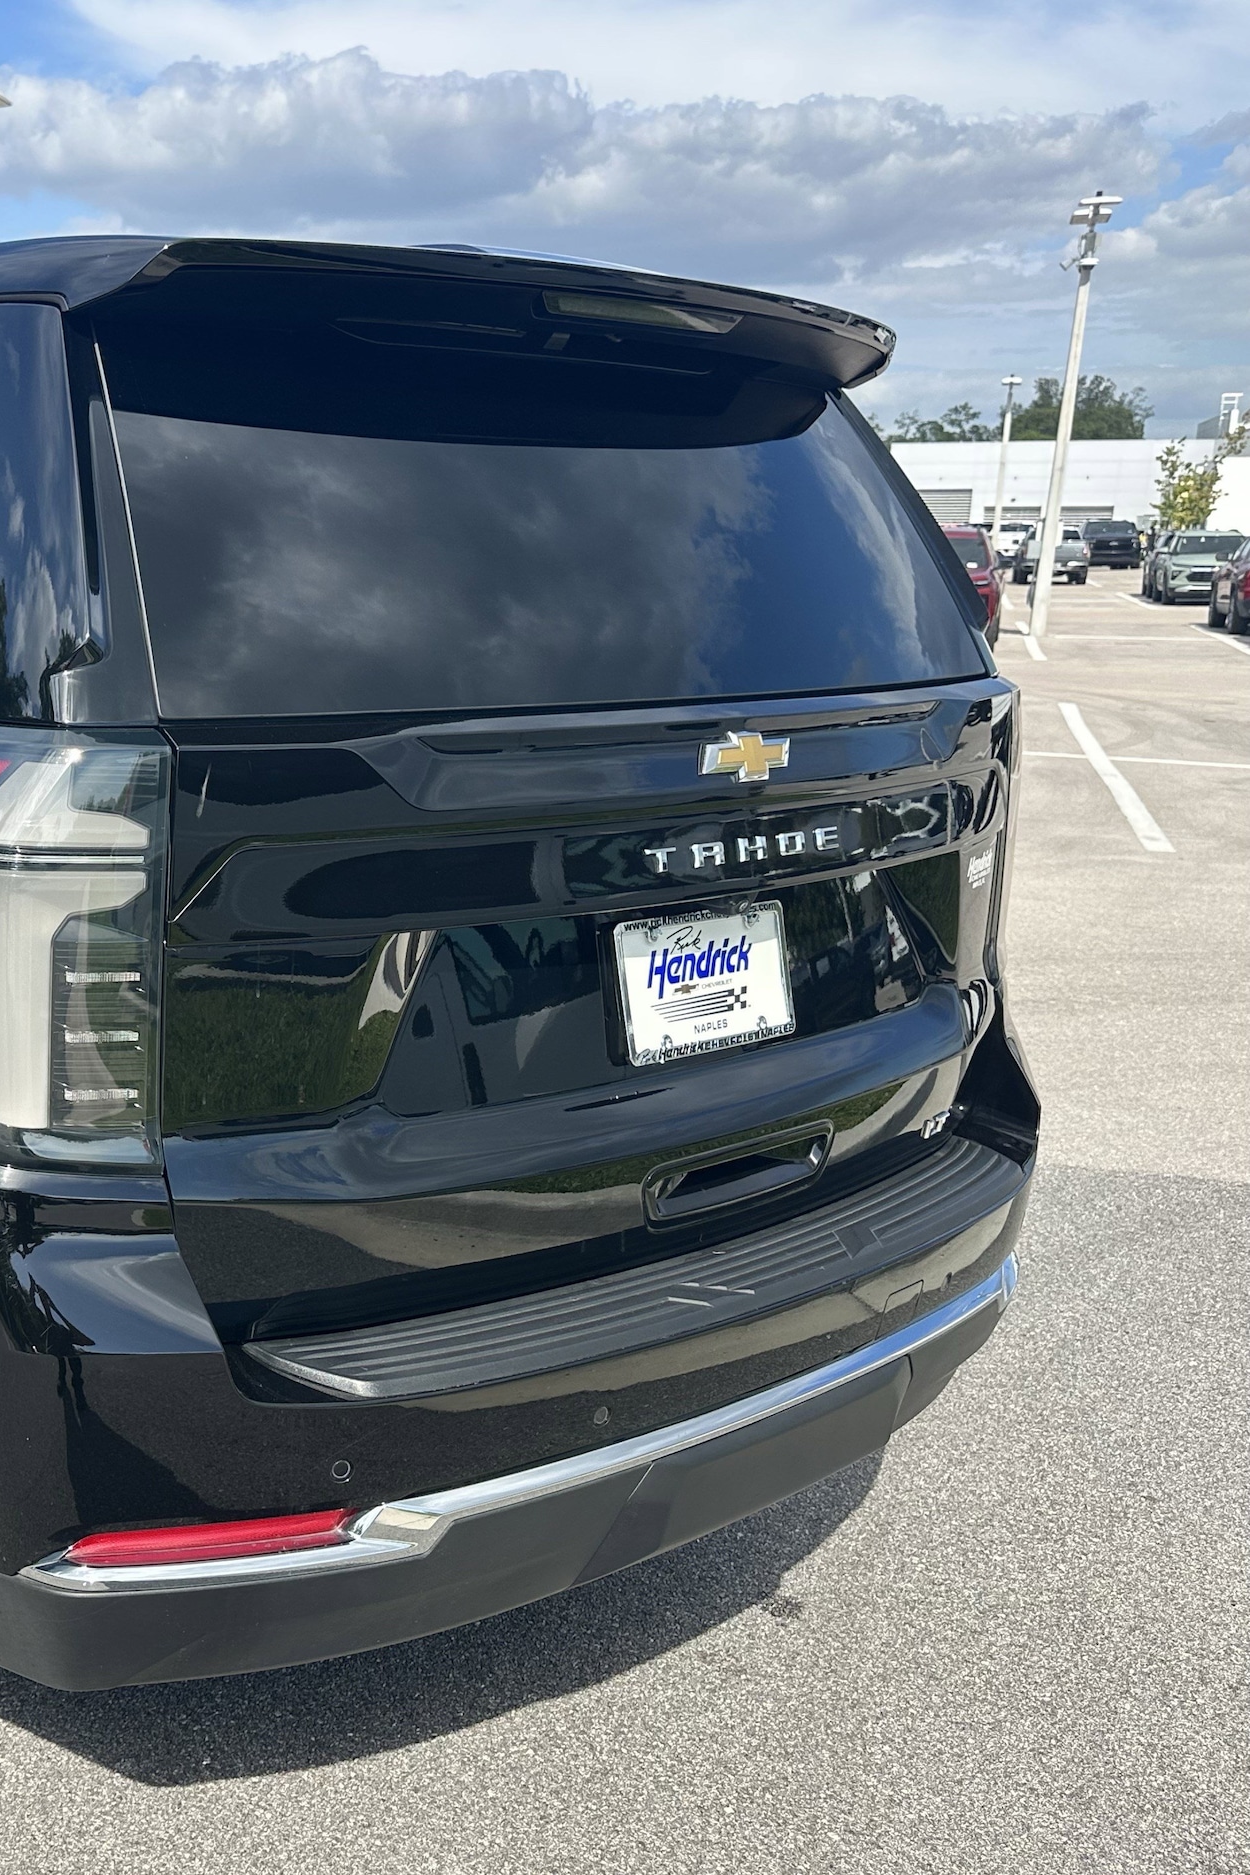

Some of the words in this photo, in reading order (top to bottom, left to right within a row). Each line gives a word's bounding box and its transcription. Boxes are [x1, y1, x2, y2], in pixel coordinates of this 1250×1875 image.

[644, 826, 840, 873] TAHOE
[667, 926, 702, 954] Rick
[647, 935, 753, 999] Hendrick
[702, 978, 733, 990] CHEVROLET
[694, 1018, 728, 1035] NAPLES
